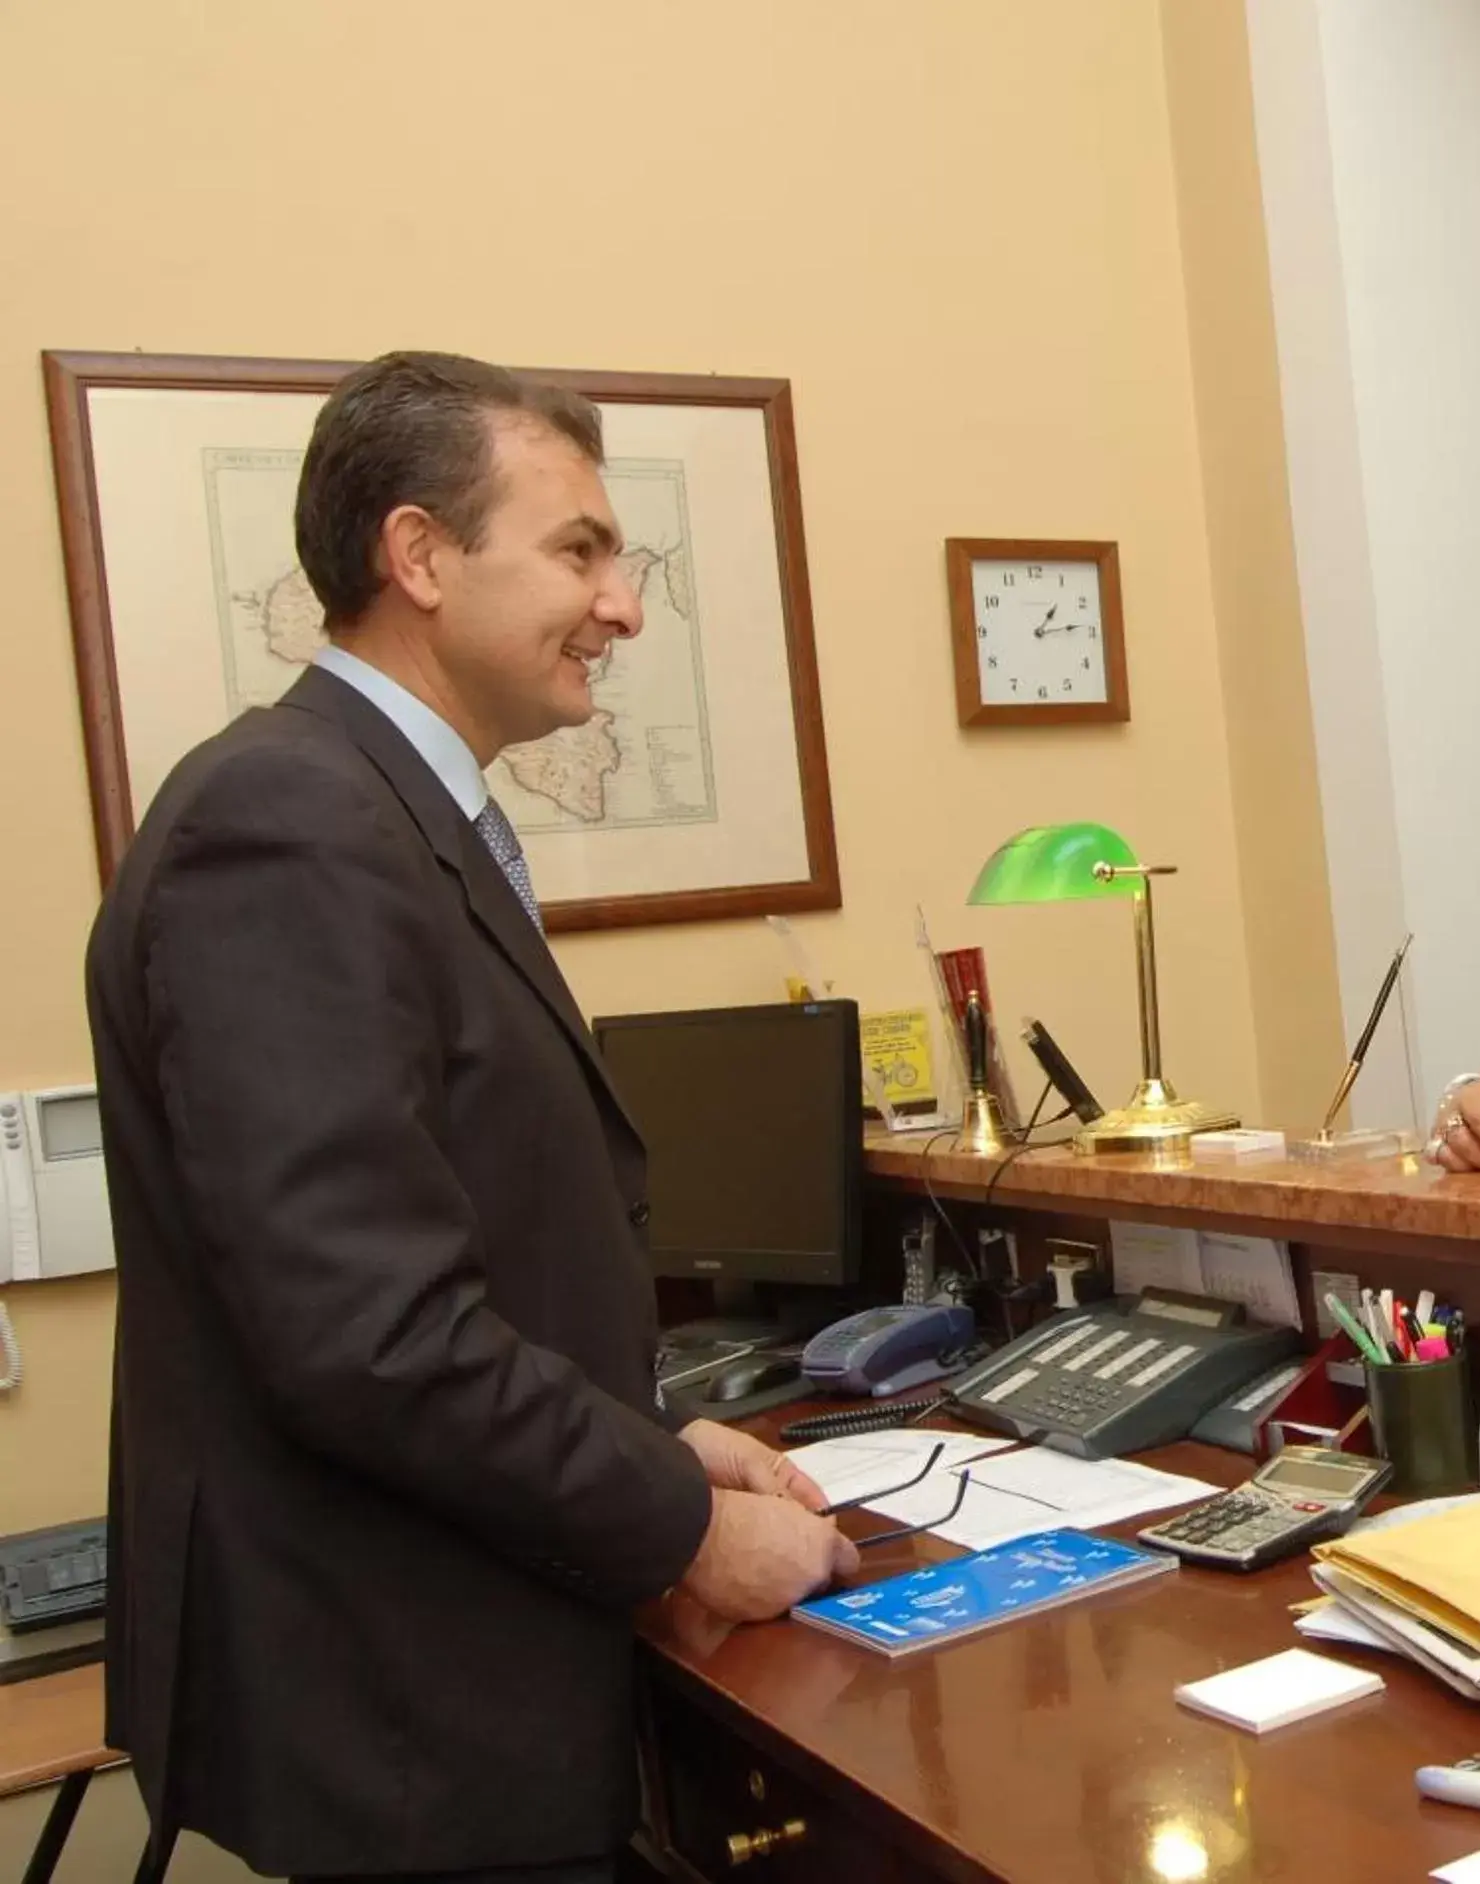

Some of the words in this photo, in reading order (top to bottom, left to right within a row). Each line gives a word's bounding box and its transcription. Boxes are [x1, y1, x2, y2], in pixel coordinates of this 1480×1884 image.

[1027, 566, 1042, 579] 12
[1003, 573, 1014, 587] 11
[985, 596, 999, 609] 10
[978, 625, 987, 638] 9
[988, 657, 997, 669] 8
[1081, 657, 1090, 670] 4
[1010, 678, 1018, 691] 7
[1063, 679, 1072, 691] 5
[1039, 686, 1047, 699] 6
